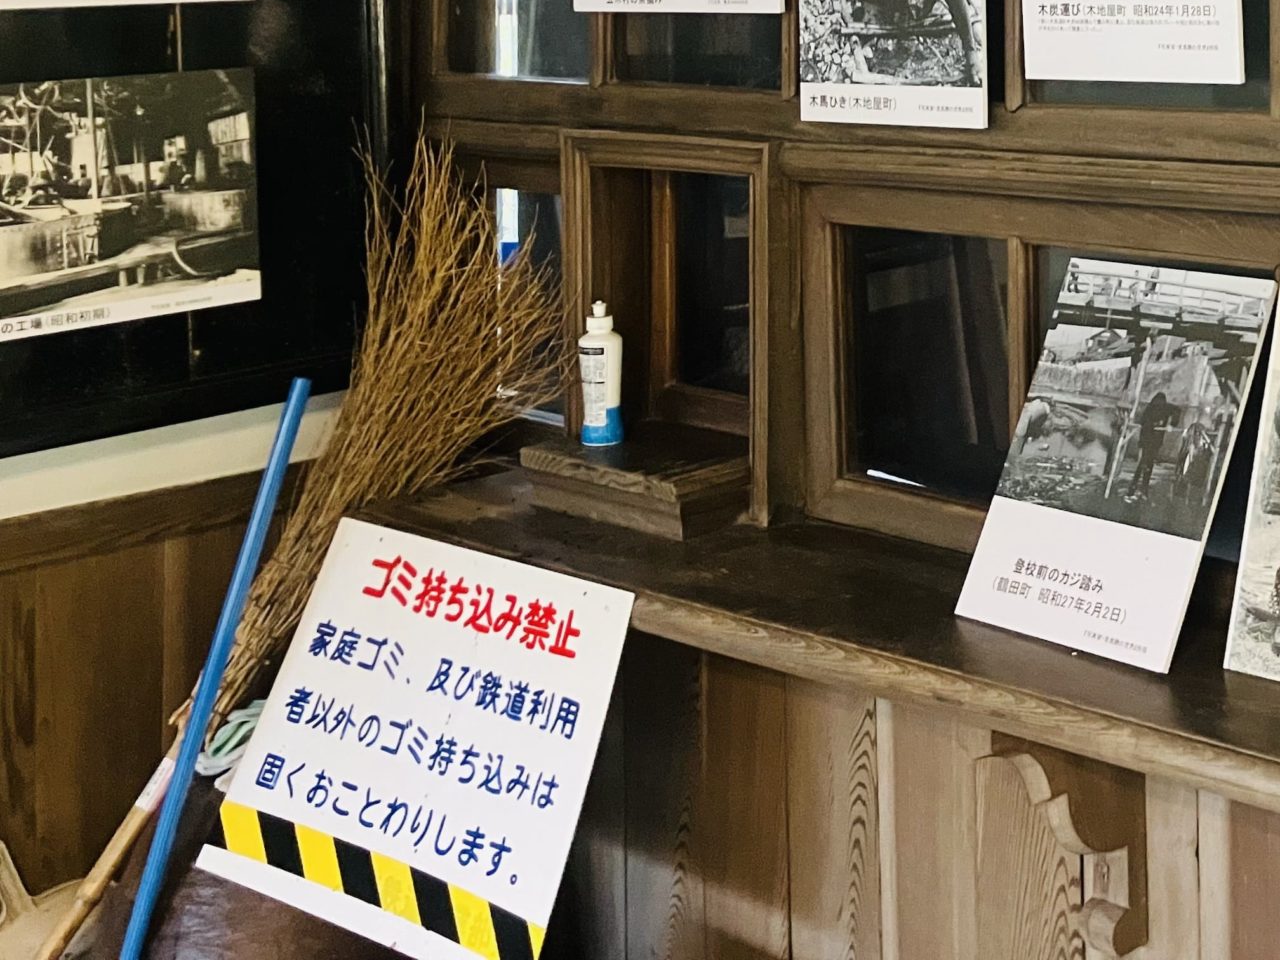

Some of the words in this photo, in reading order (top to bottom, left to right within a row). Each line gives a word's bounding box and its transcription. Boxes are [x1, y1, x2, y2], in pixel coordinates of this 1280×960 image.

[362, 555, 582, 659] ゴミ持ち込み禁止
[1013, 557, 1104, 594] 登校前のカジ踏み
[284, 686, 560, 809] 者以外のゴミ持ち込みは
[255, 752, 519, 886] 固くおことわりします。
